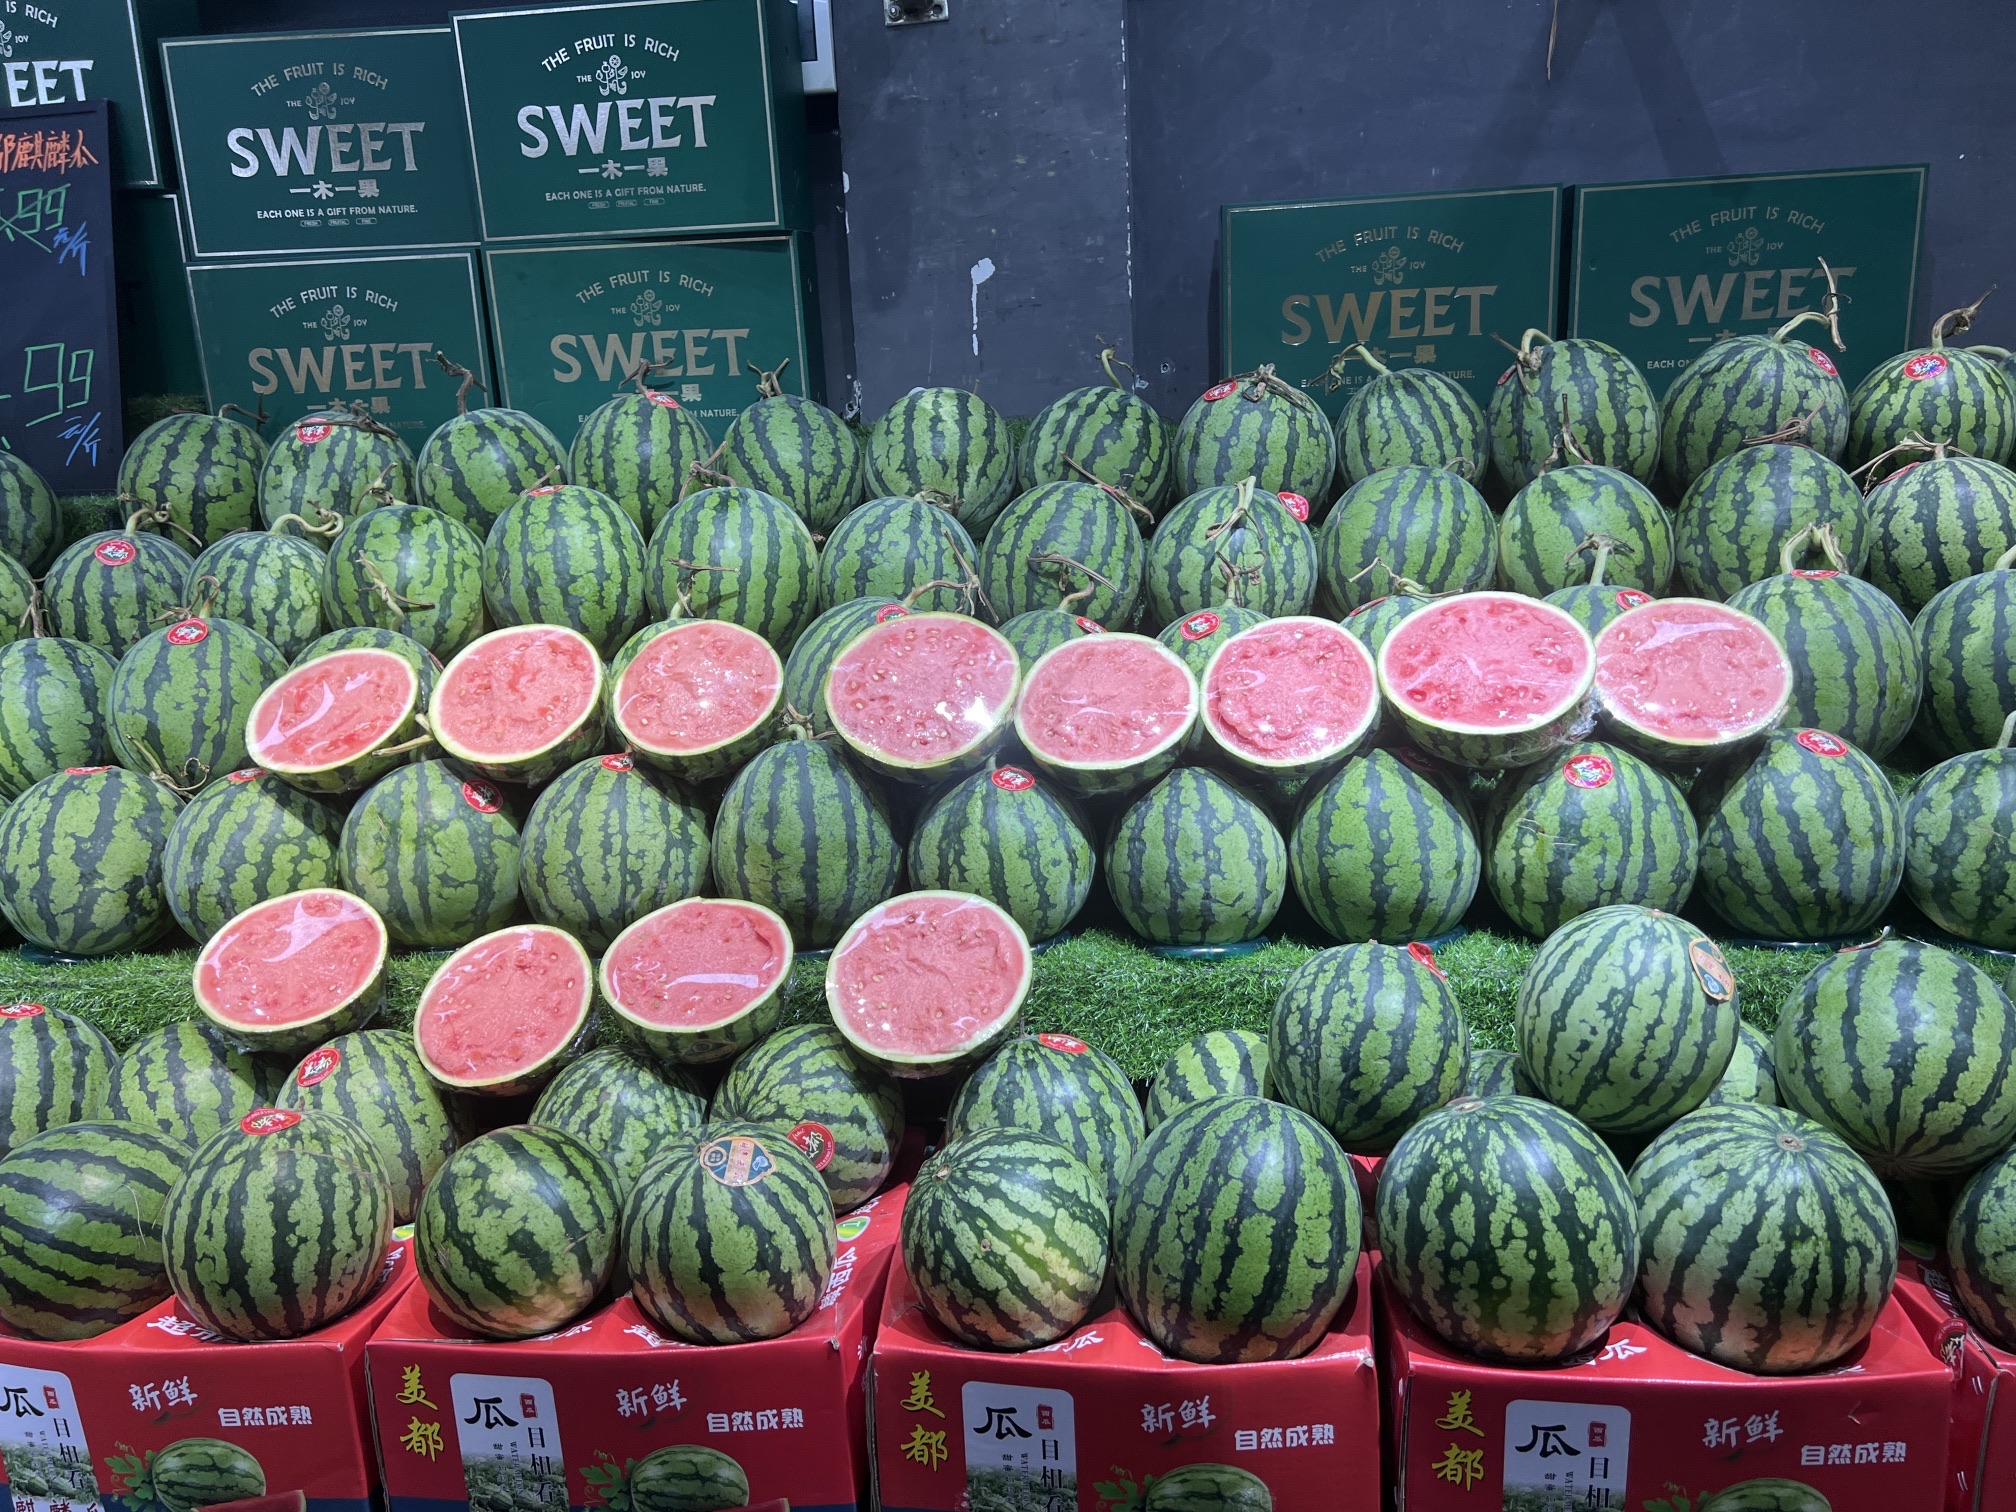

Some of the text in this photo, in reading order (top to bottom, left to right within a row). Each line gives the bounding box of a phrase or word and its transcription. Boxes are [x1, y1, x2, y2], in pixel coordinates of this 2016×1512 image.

[6, 0, 57, 28] IS RICH
[541, 33, 680, 72] THE FRUIT IS RICH
[251, 62, 388, 97] THE FRUIT IS RICH
[576, 71, 646, 83] THE JOY
[286, 100, 302, 108] THE
[517, 95, 717, 159] SWEET
[227, 121, 425, 178] SWEET
[578, 157, 668, 180] 一木一果
[289, 179, 380, 200] 一木一果
[545, 183, 707, 202] EACH ONE IS A GIFT FROM NATURE.
[257, 204, 418, 219] EACH ONE IS A GIFT FROM NATURE.
[1669, 206, 1825, 244] THE FRUIT IS RICH
[1315, 226, 1464, 263] THE FRUIT IS RICH
[1706, 242, 1784, 255] THE JOY
[1350, 261, 1426, 273] THE JOY
[269, 286, 398, 319] THE FRUIT IS RICH
[575, 270, 714, 304] THE FRUIT IS RICH
[1629, 267, 1857, 327] SWEET
[611, 307, 626, 315] THE
[1281, 285, 1498, 346] SWEET
[248, 342, 434, 395] SWEET
[550, 328, 750, 383] SWEET
[1647, 359, 1696, 369] EACH ON
[1354, 376, 1363, 384] IS
[700, 408, 740, 418] NATURE.
[0, 1386, 45, 1418] 瓜
[128, 1375, 198, 1412] 新鲜
[614, 1379, 688, 1419] 新鲜
[217, 1405, 313, 1427] 自然成熟
[396, 1364, 444, 1463] 美都
[463, 1396, 519, 1429] 瓜
[706, 1407, 804, 1434] 自然成熟
[900, 1369, 949, 1472] 美都
[972, 1406, 1033, 1440] 瓜
[1140, 1394, 1216, 1434] 新鲜
[1234, 1423, 1335, 1452] 自然成熟
[1431, 1388, 1485, 1492] 美都
[1515, 1424, 1582, 1458] 瓜
[1701, 1409, 1784, 1450] 新鲜
[1800, 1439, 1907, 1467] 自然成熟
